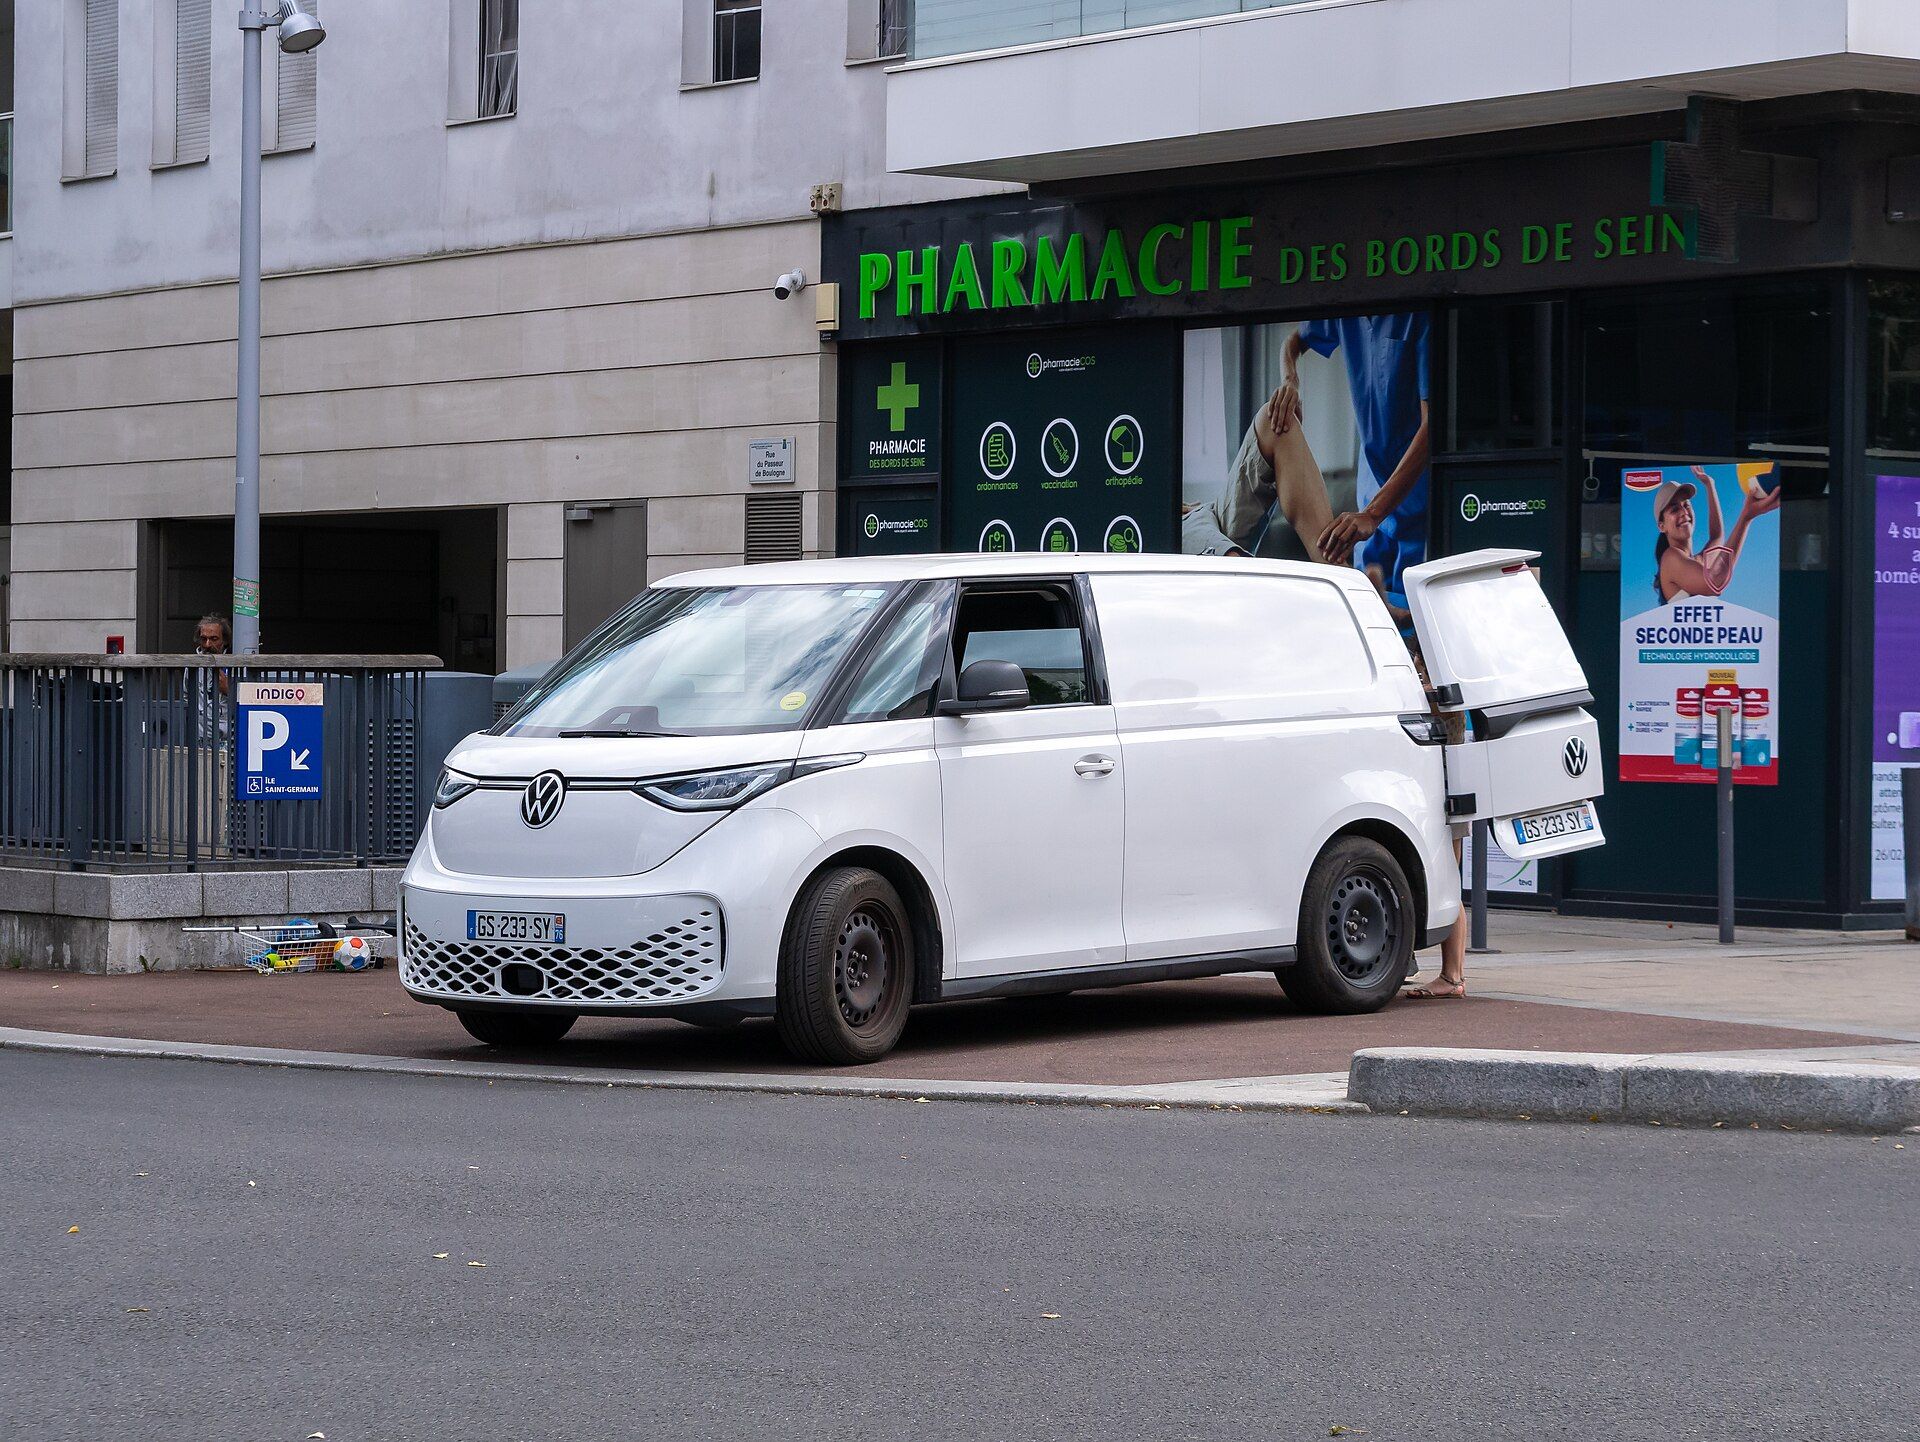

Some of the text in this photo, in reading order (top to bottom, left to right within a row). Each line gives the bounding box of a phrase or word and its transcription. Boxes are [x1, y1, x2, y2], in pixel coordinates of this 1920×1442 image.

[860, 213, 1686, 319] PHARMACIE DES BORDS DE SEIN
[869, 438, 926, 455] PHARMACIE
[764, 460, 784, 468] Passeur
[869, 457, 926, 468] DES BORDS DE SEINE
[762, 469, 786, 478] Boulogne
[976, 481, 1019, 491] ordonnances
[1040, 479, 1078, 489] vaccination
[1105, 475, 1143, 488] orthopédie
[1887, 521, 1900, 538] 4
[1874, 567, 1920, 584] omé
[1673, 605, 1724, 623] EFFET
[1635, 626, 1763, 644] SECONDE PEAU
[1642, 650, 1756, 661] TECHNOLOGIE HYDROCOLLOÏDE
[256, 688, 305, 701] INDIGO
[247, 710, 290, 772] P
[265, 776, 276, 785] ÎLE
[1523, 811, 1582, 838] GS-233-SY
[477, 914, 551, 939] GS-233-SY
